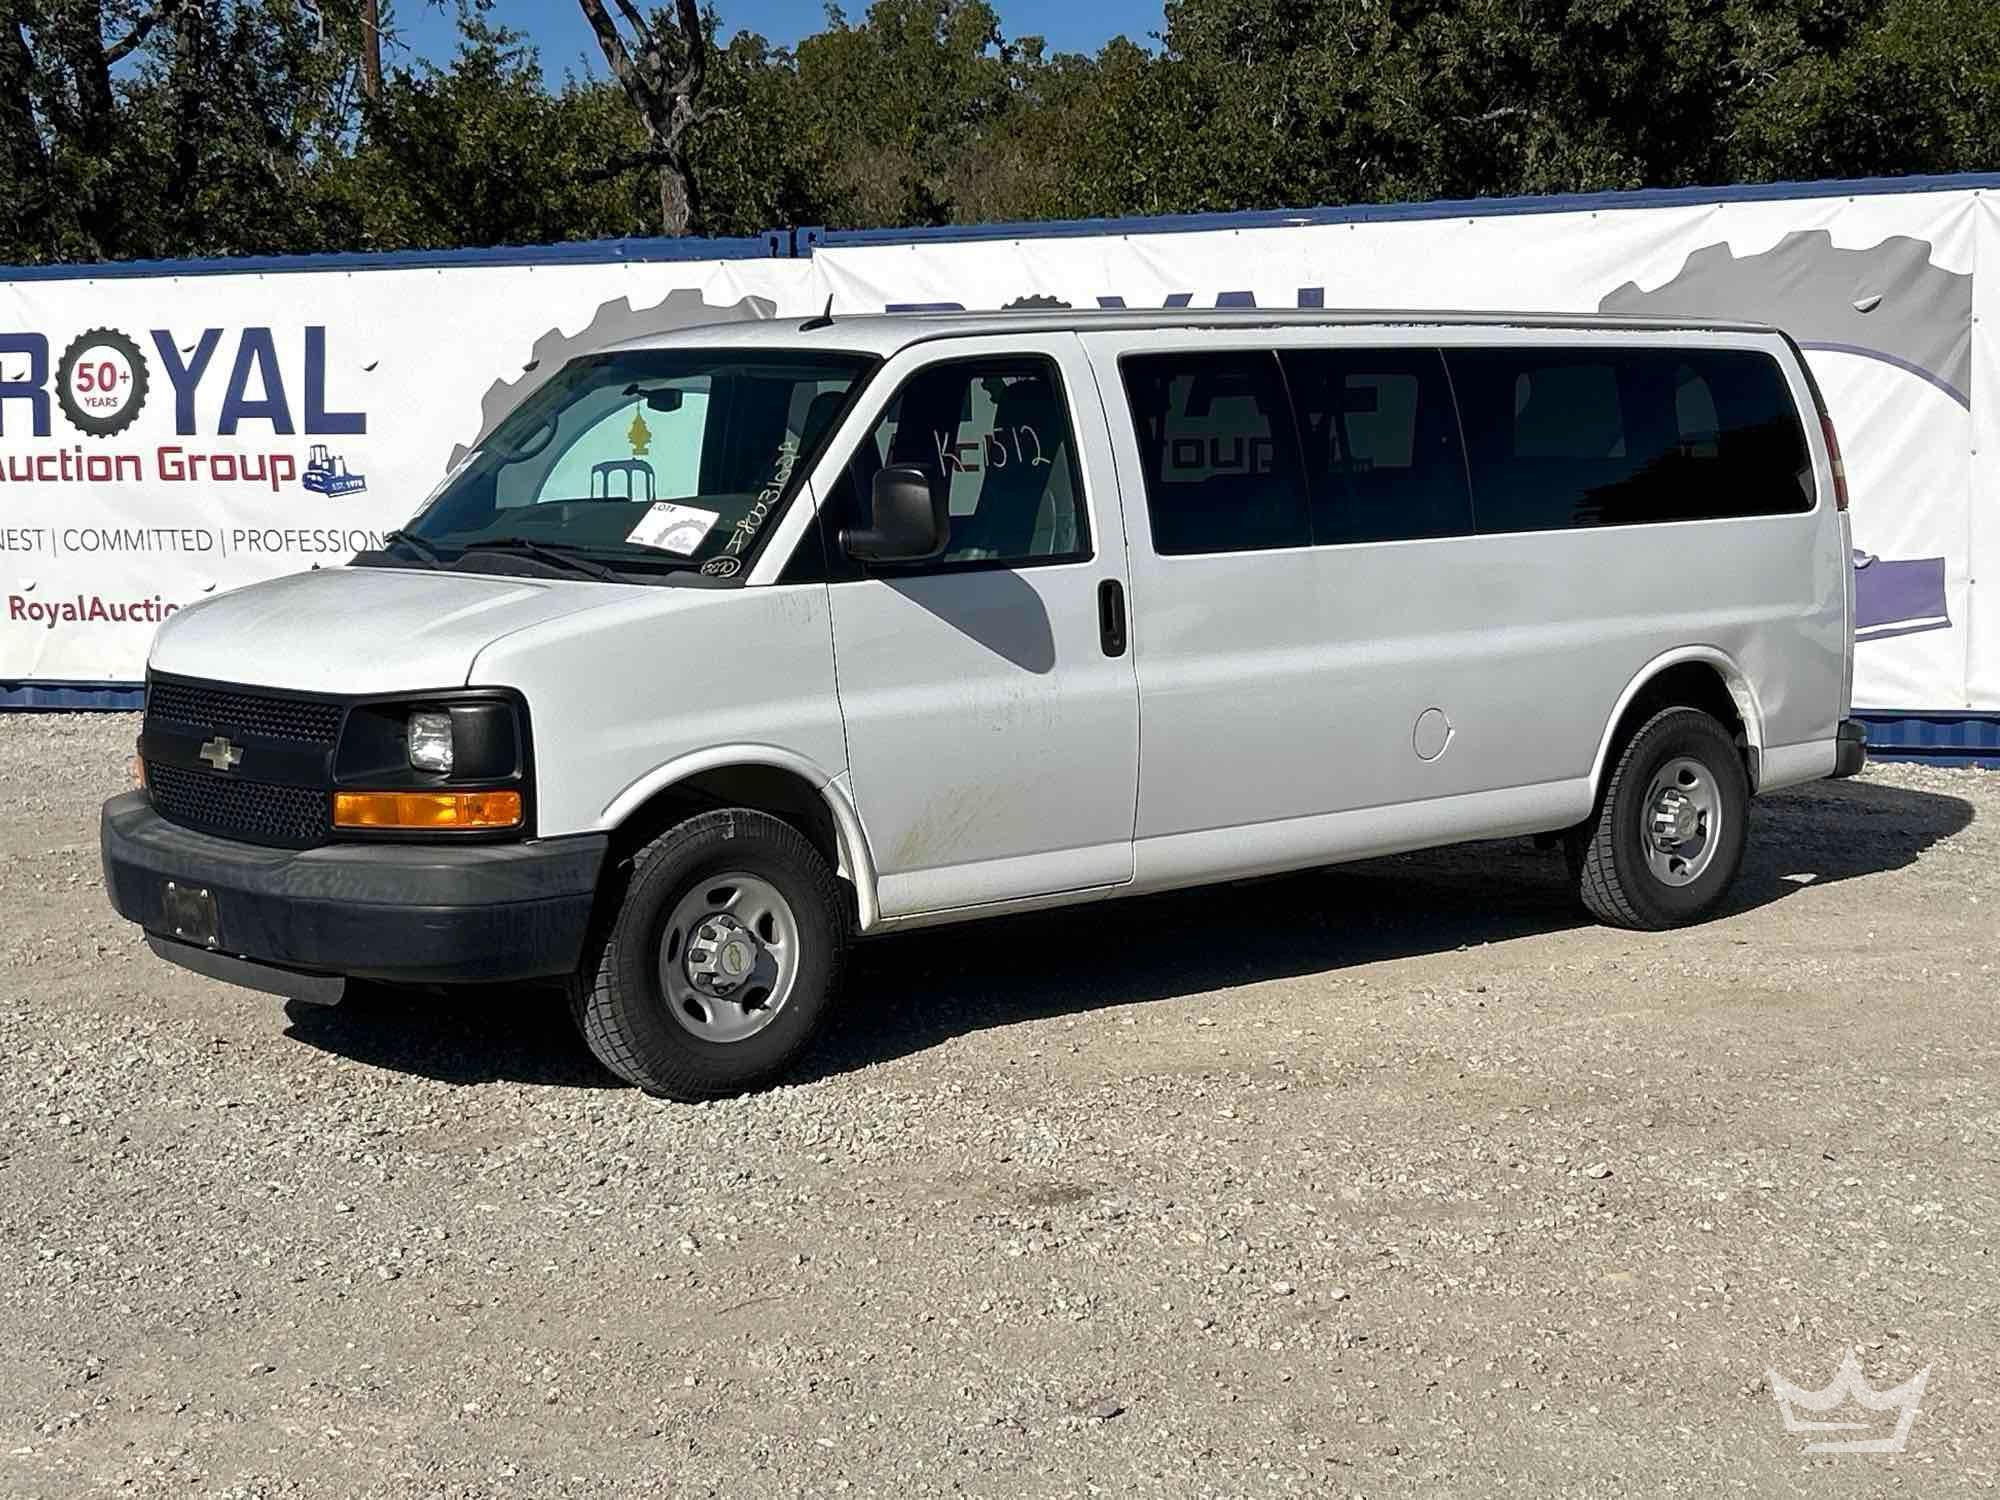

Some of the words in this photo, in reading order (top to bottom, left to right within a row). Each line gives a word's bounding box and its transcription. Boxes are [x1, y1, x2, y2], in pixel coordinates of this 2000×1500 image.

[76, 361, 130, 392] 50+
[84, 396, 118, 408] YEARS
[0, 444, 143, 482] uction
[157, 446, 296, 492] Group
[0, 528, 44, 551] EST
[63, 528, 213, 552] COMMITTED
